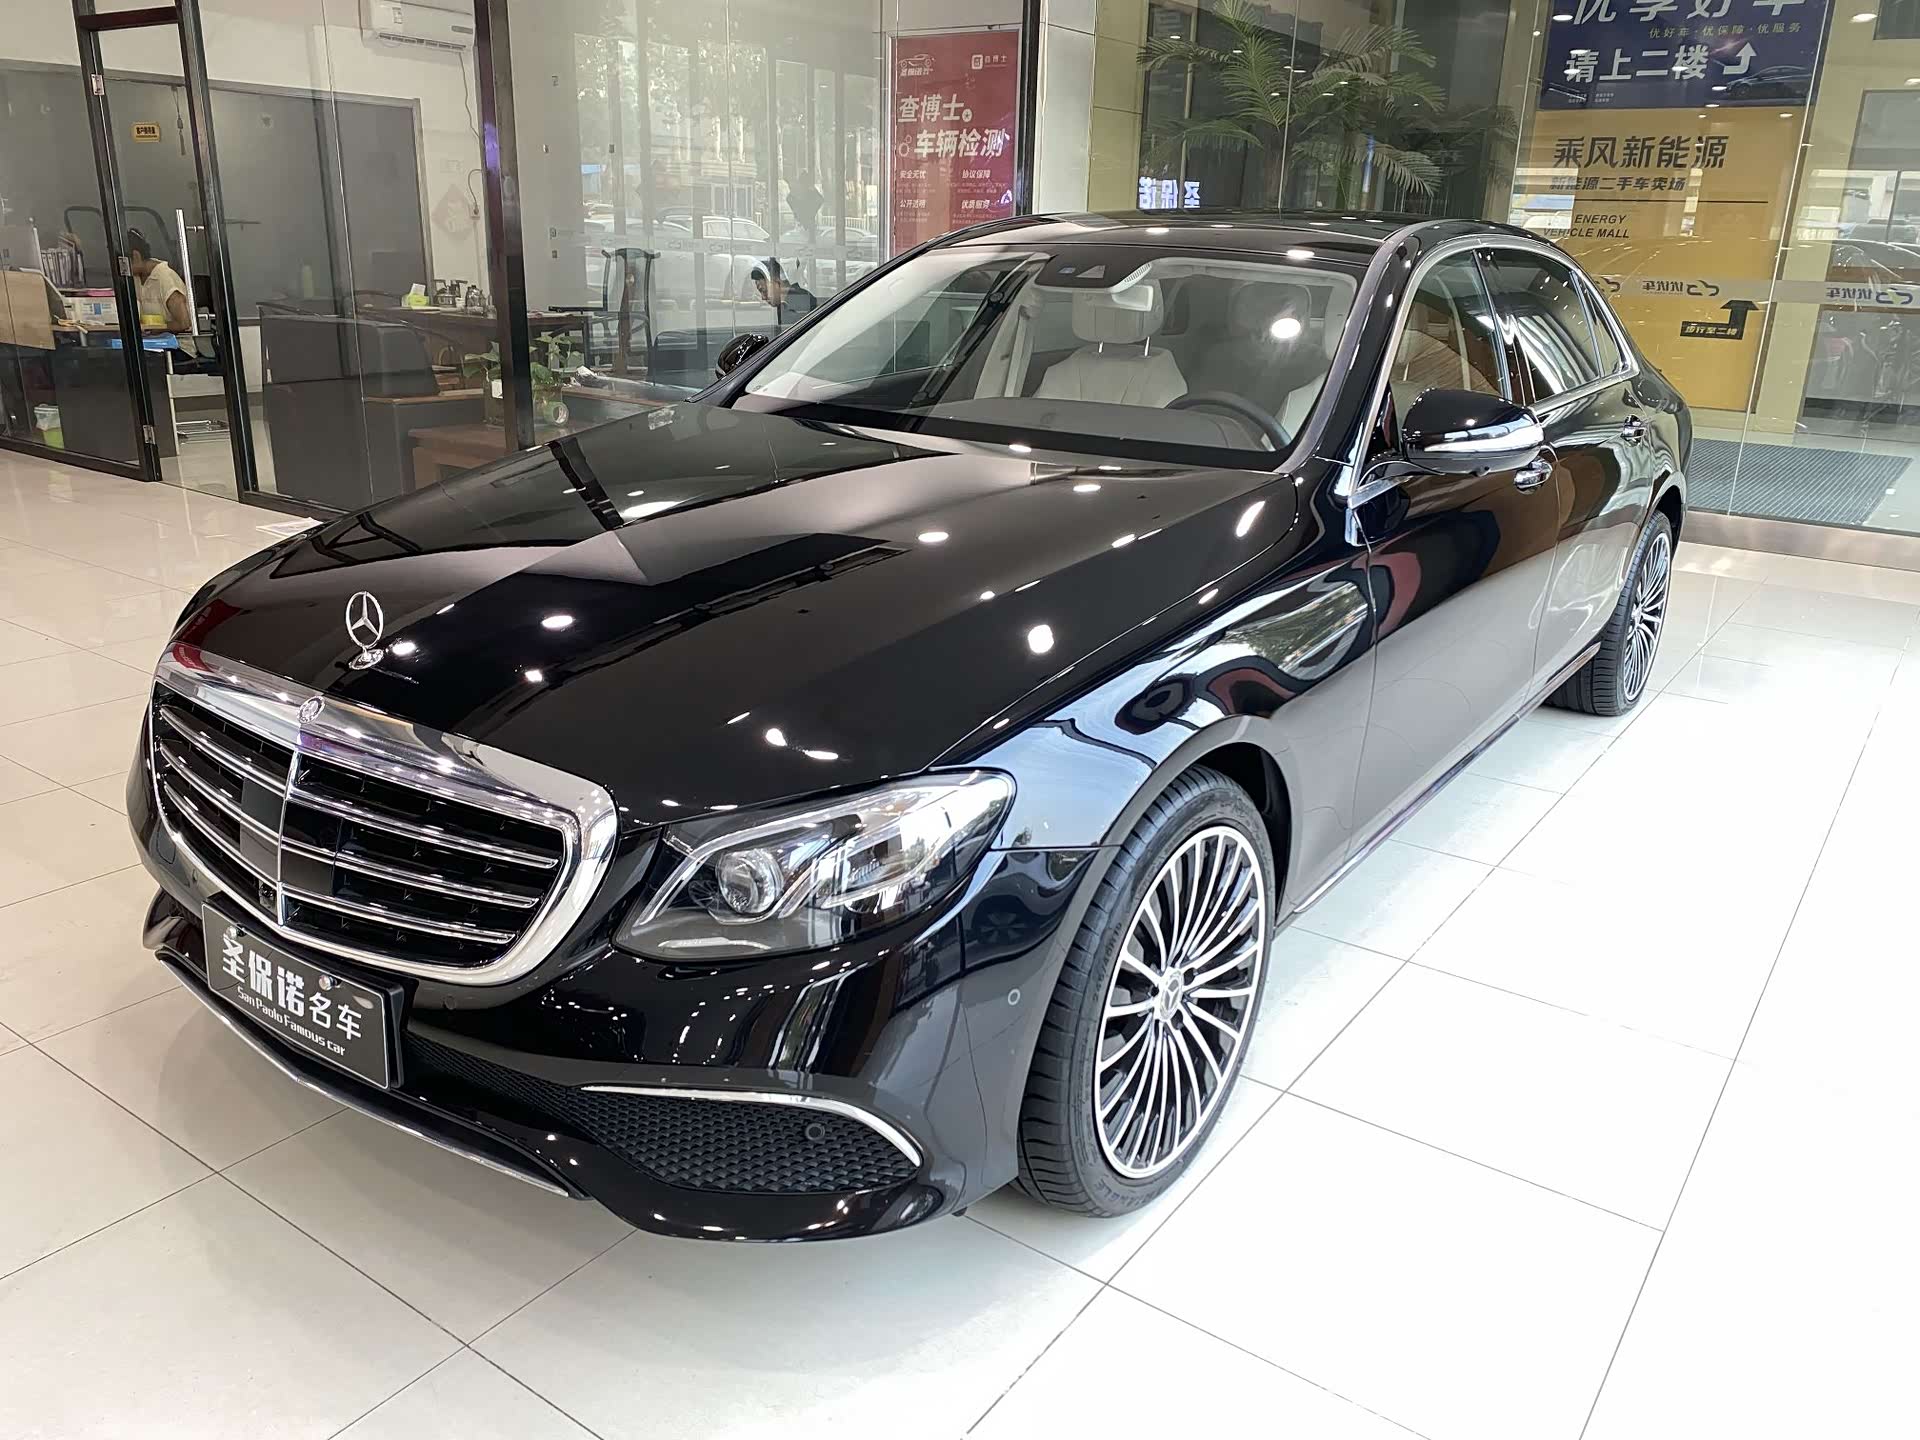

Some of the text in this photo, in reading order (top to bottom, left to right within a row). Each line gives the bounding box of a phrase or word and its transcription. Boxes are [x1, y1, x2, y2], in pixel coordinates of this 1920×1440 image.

[1566, 44, 1709, 83] 请上二楼
[897, 92, 965, 123] 查博士
[914, 127, 1006, 158] 车辆检测
[1552, 135, 1730, 169] 乘风新能源
[1549, 176, 1688, 192] 新能源二手车卖场
[1543, 227, 1630, 239] VEHICLE MALL
[1574, 214, 1627, 225] ENERGY
[222, 933, 362, 1040] 圣保诺名车
[237, 985, 255, 1005] San
[284, 1015, 326, 1047] Famous
[327, 1039, 346, 1056] car
